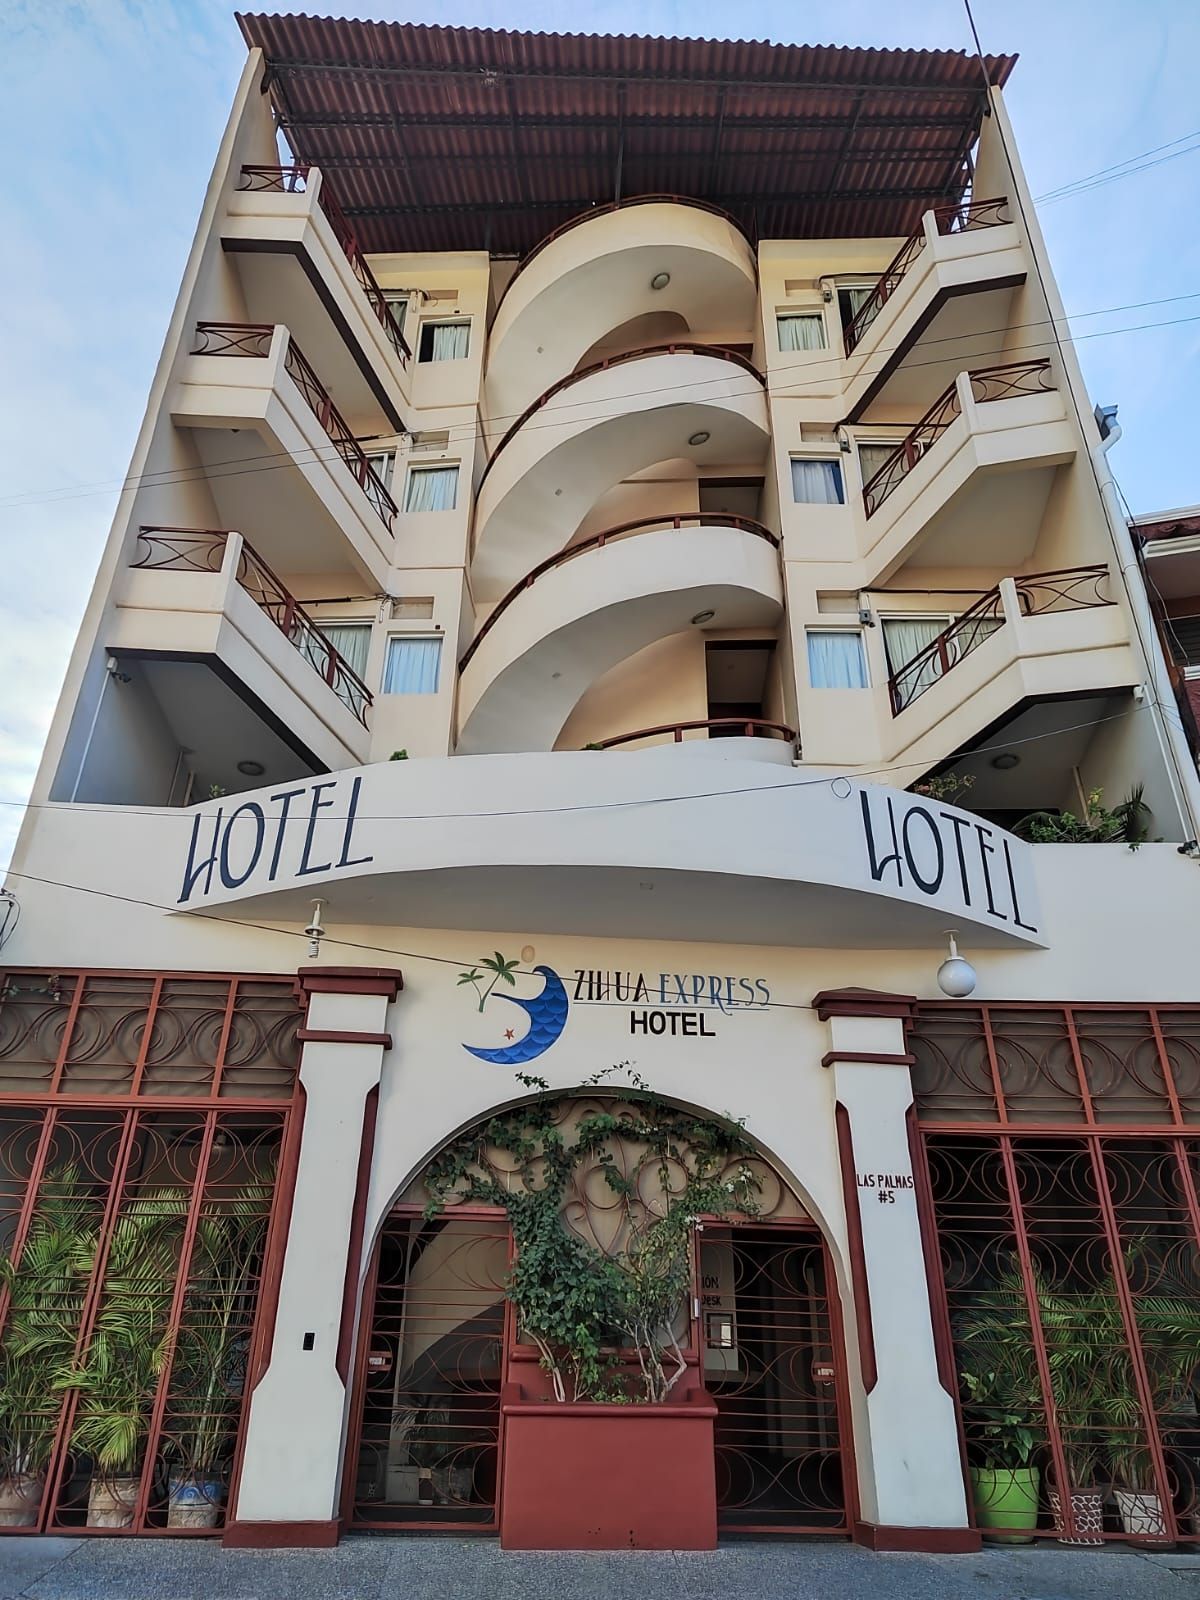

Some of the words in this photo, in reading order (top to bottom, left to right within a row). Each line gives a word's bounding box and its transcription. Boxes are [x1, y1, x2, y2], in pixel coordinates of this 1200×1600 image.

[177, 776, 374, 904] HOTEL
[859, 790, 1038, 933] HOTEL
[573, 969, 650, 1003] ZIHUA
[658, 973, 771, 1016] EXPRESS
[630, 1010, 716, 1037] HOTEL
[856, 1173, 876, 1188] LAS
[877, 1174, 914, 1189] PALMAS
[877, 1189, 896, 1204] #5
